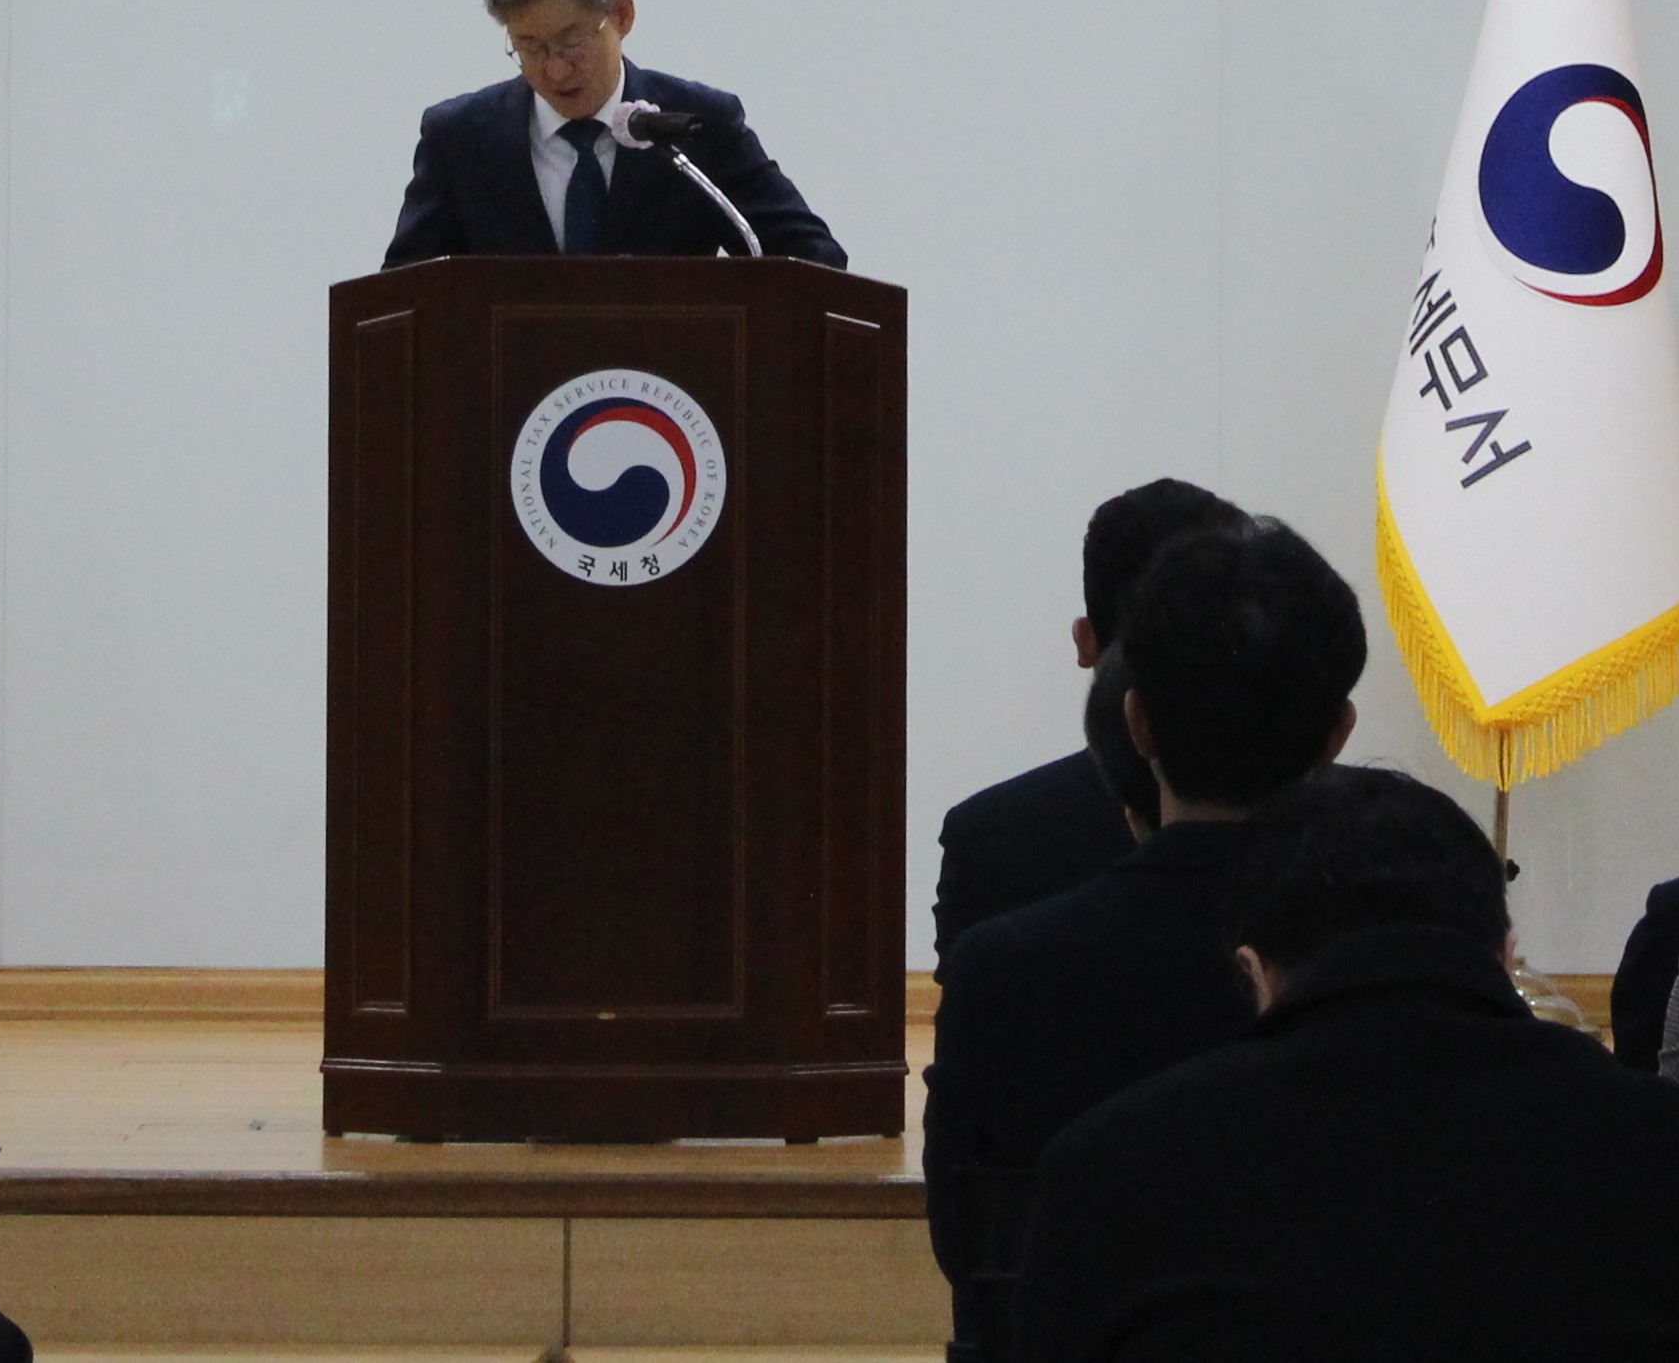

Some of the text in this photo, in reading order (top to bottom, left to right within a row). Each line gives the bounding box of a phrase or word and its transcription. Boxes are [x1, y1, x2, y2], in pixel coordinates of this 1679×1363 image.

[1409, 215, 1532, 490] 세무서
[520, 377, 718, 550] NATIONAL TAX SERVICE REPUBLIC OF KOREA
[577, 554, 662, 582] 국세청
